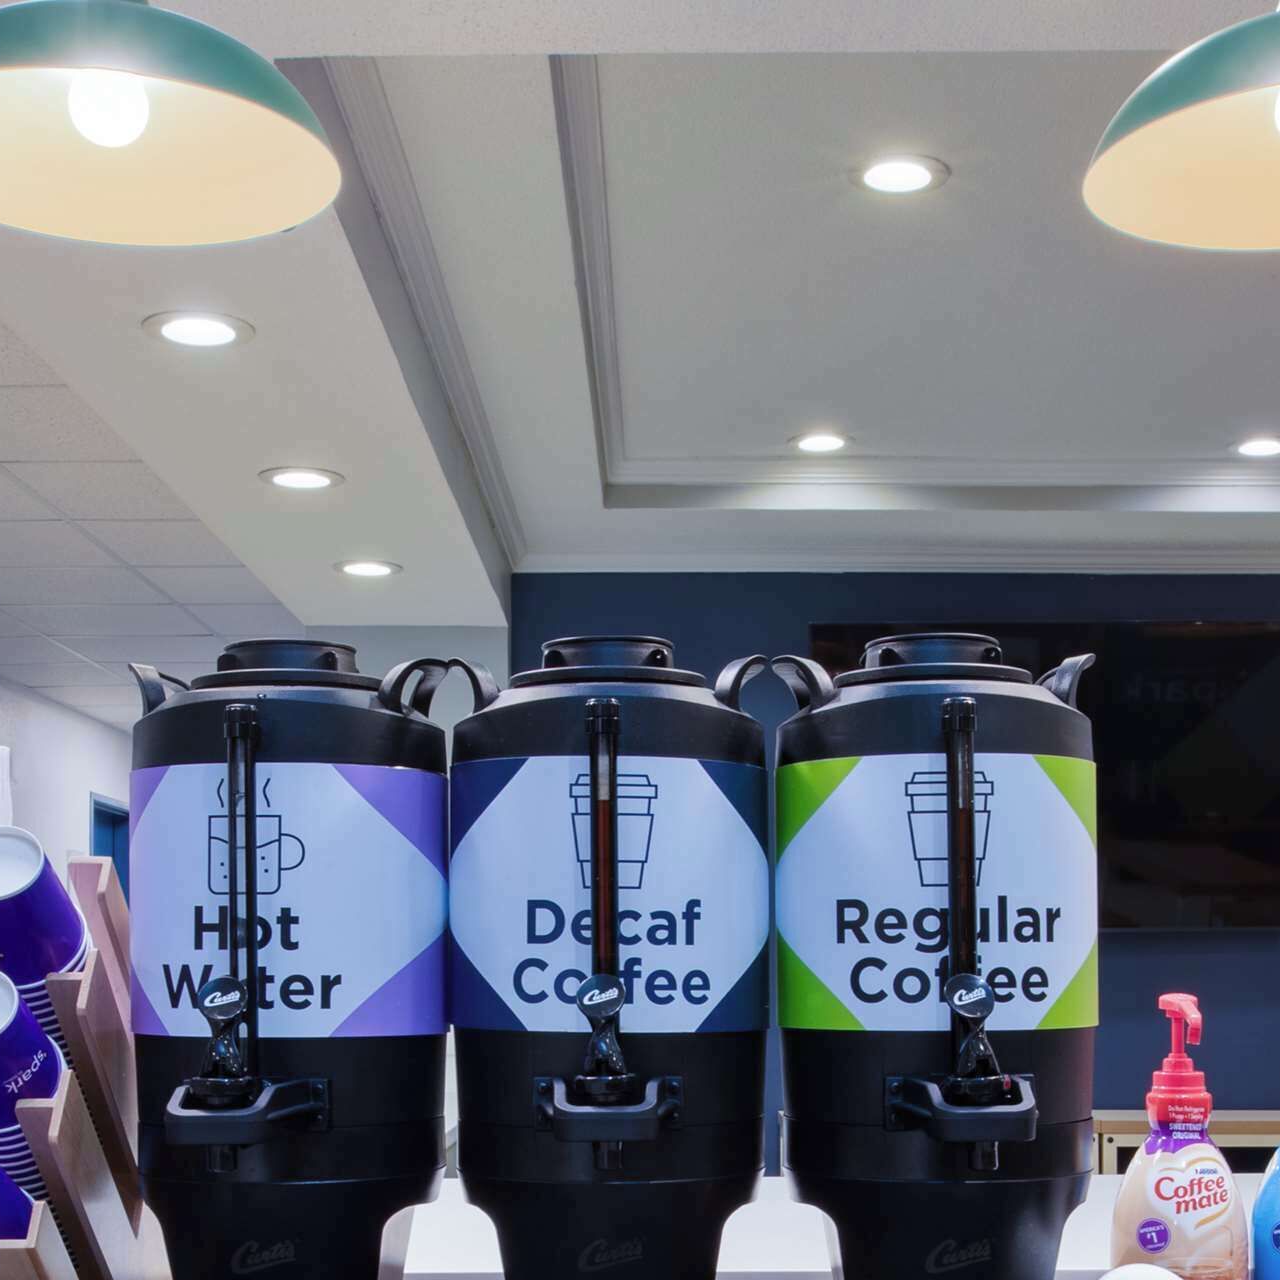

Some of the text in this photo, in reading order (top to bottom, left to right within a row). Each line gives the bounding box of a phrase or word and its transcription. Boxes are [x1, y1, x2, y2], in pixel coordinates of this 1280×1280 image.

[526, 898, 701, 946] Decaf
[162, 964, 342, 1010] Wter
[513, 956, 711, 1005] Cofee
[1154, 1176, 1225, 1201] Coffee
[1175, 1189, 1228, 1214] mate
